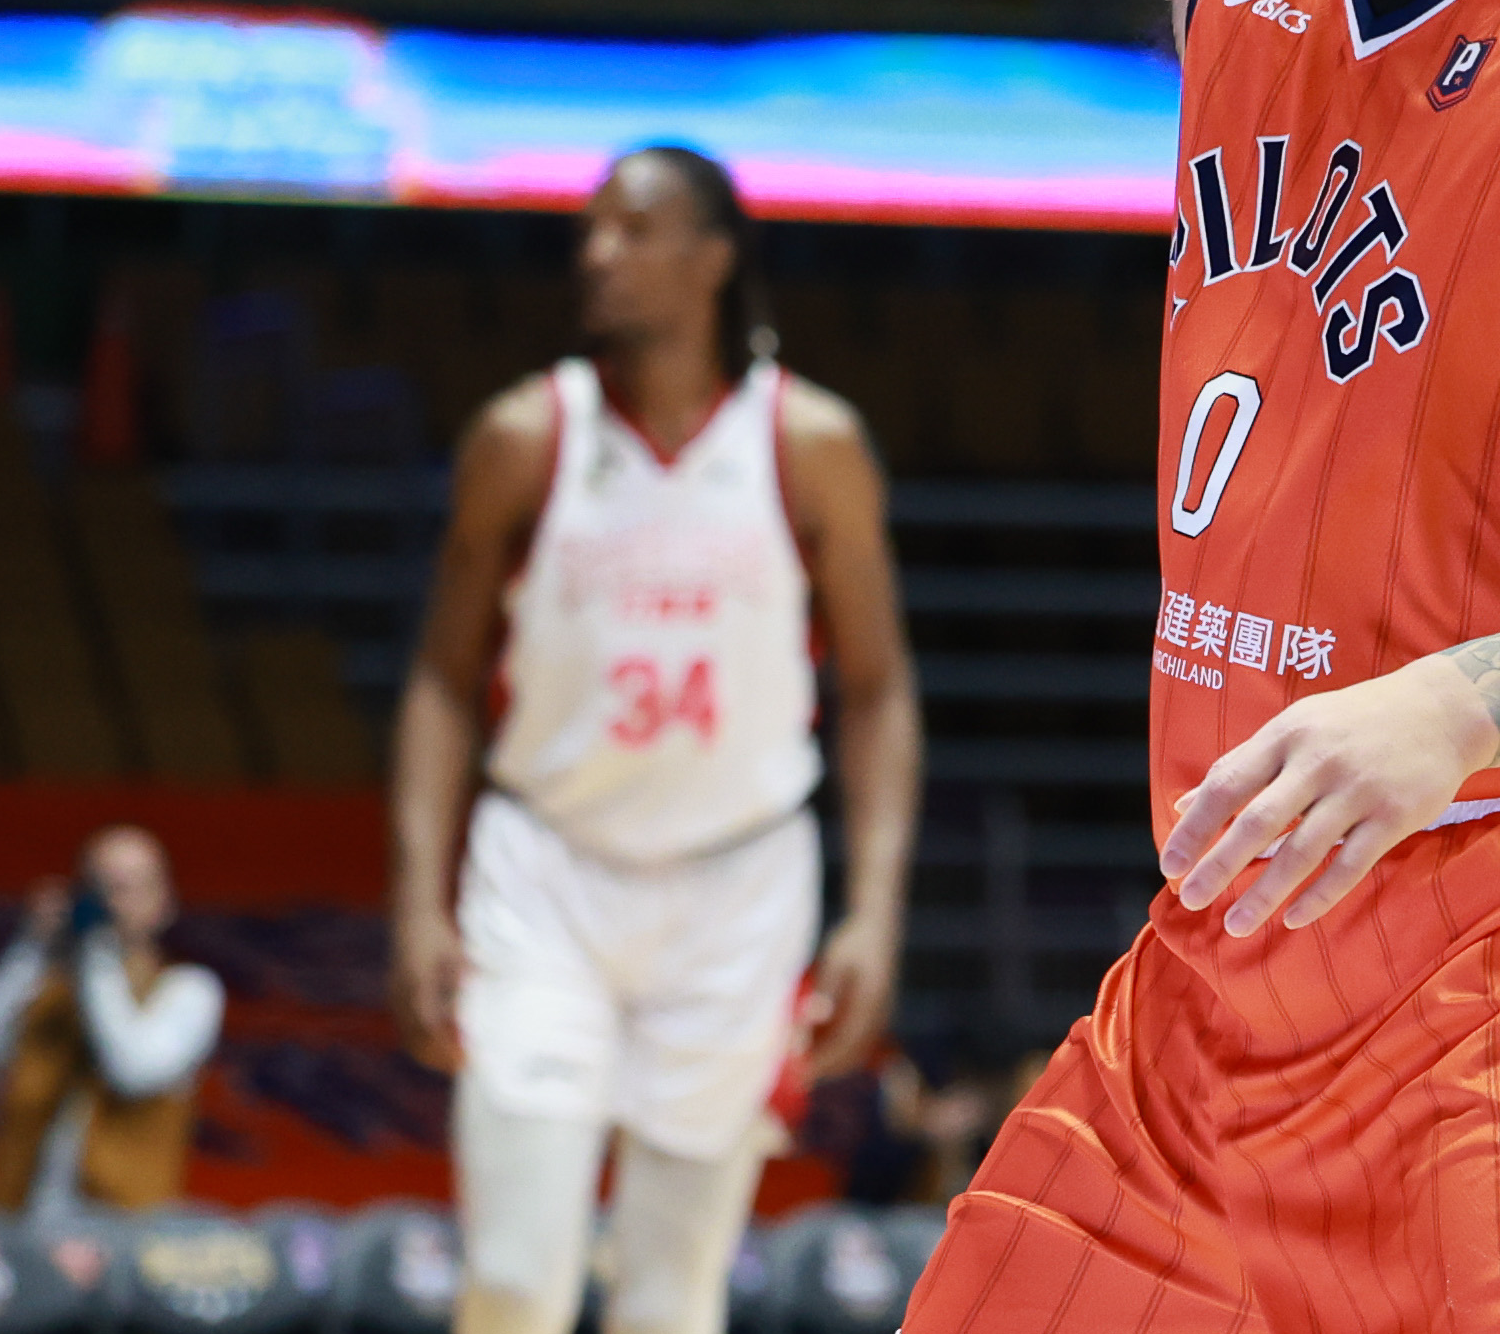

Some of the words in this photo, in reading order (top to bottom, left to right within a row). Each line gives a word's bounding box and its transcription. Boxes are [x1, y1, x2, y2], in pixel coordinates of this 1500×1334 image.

[1442, 41, 1481, 86] P
[1170, 370, 1263, 540] 0
[1156, 578, 1337, 680] 建築團隊
[604, 651, 719, 752] 34
